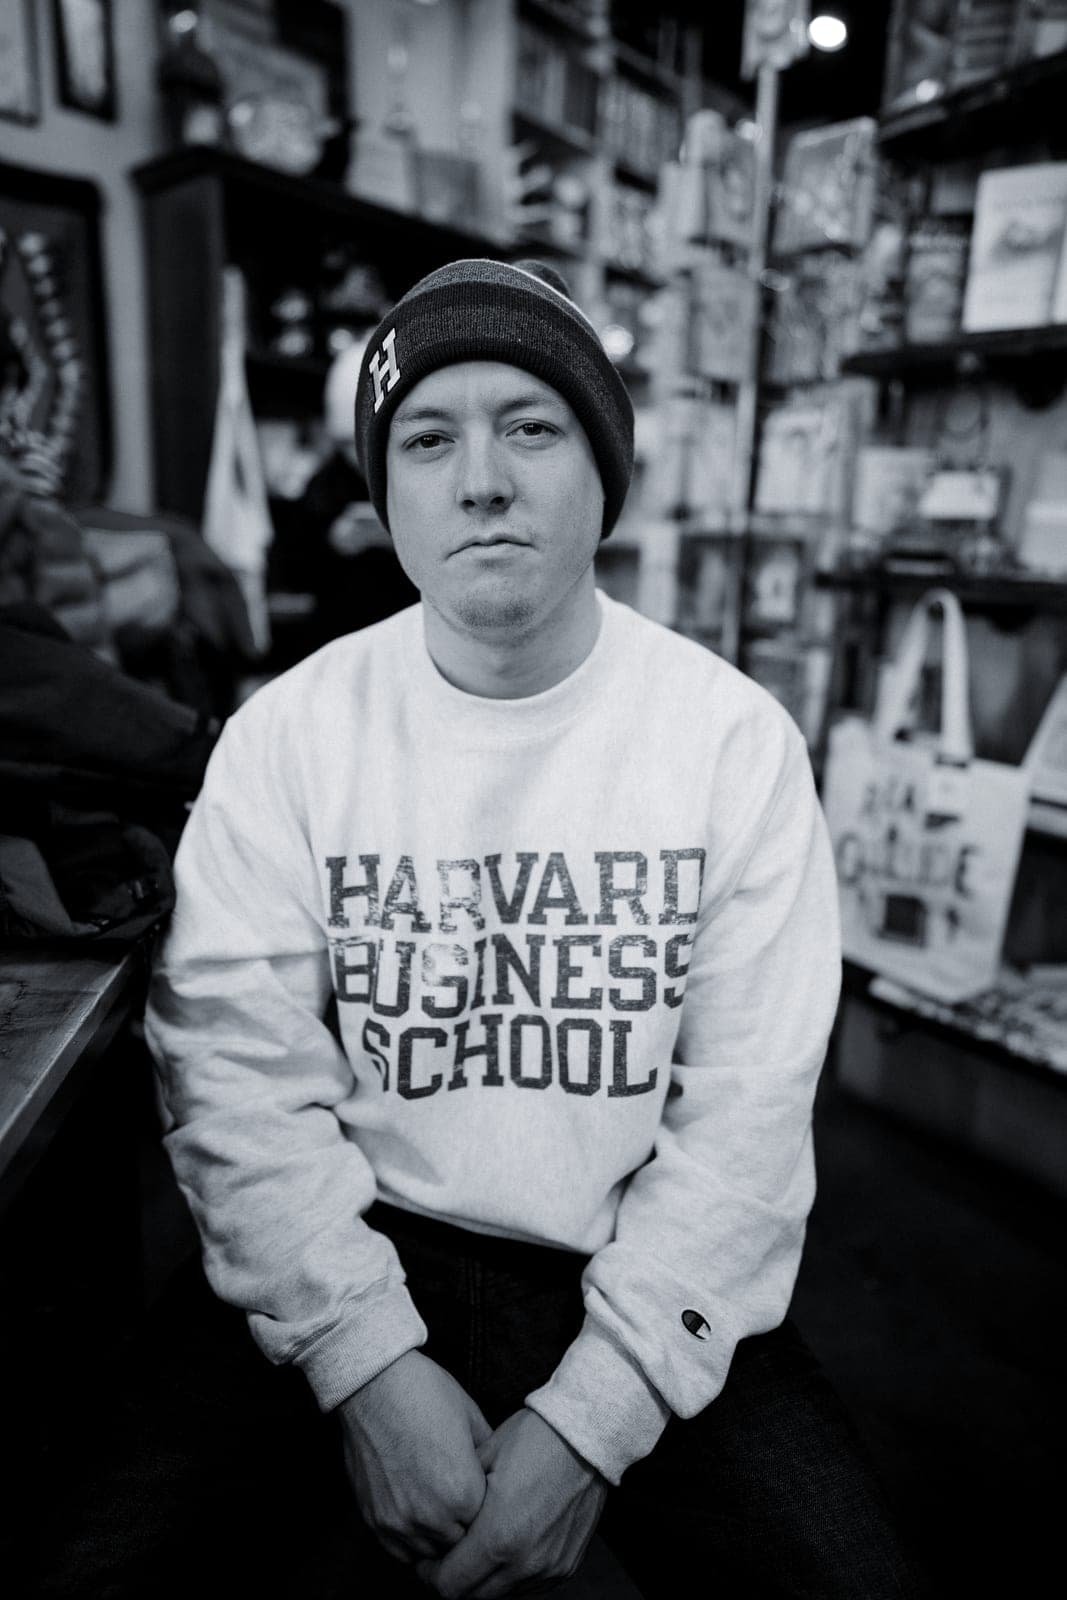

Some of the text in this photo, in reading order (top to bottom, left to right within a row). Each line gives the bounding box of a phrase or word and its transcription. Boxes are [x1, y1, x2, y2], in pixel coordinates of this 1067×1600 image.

[369, 328, 400, 413] H
[325, 848, 706, 933] HARVARD
[329, 933, 695, 1019] BUSINESS
[362, 1013, 658, 1100] SCHOOL
